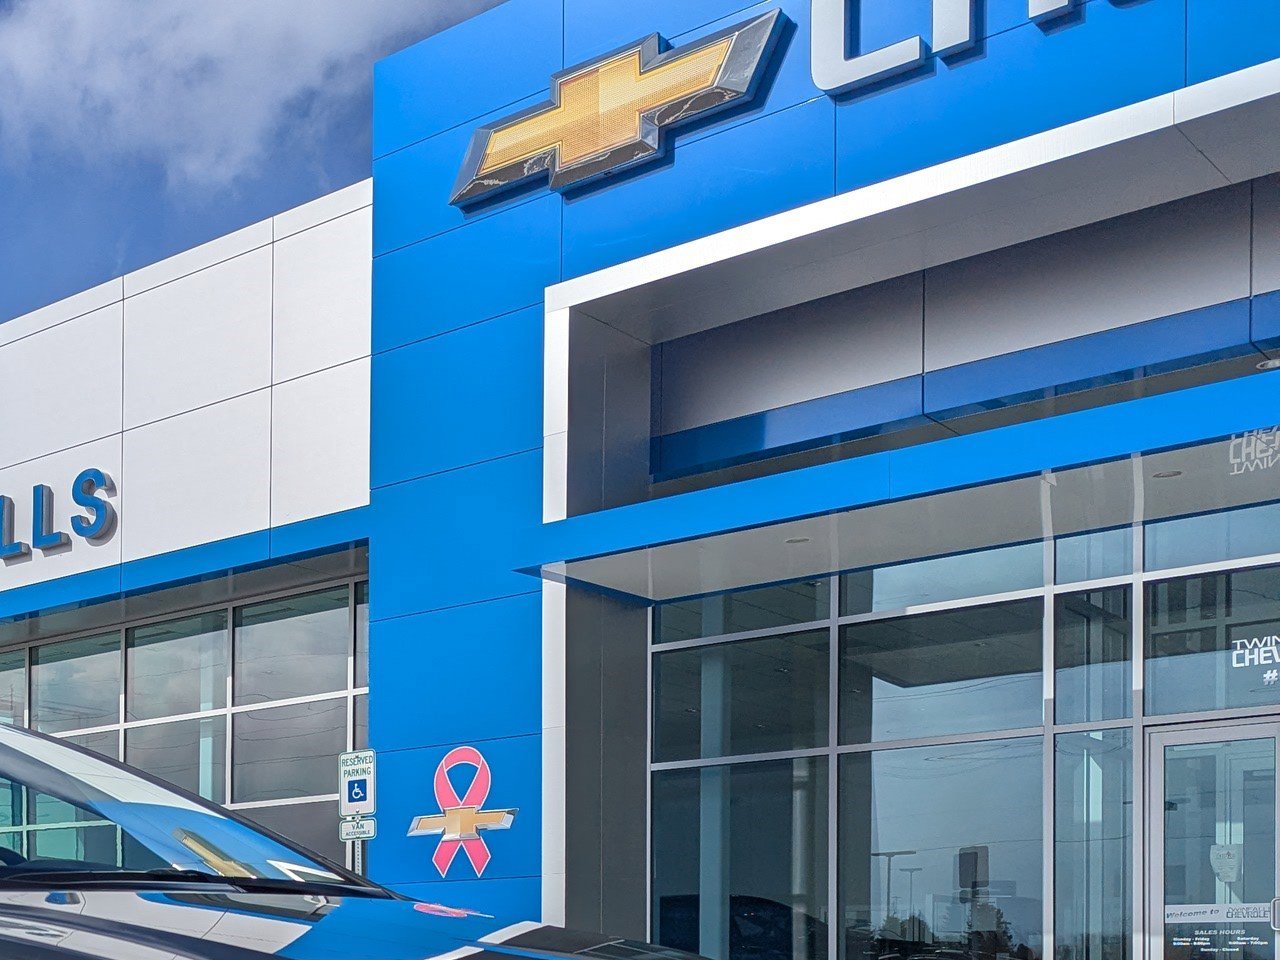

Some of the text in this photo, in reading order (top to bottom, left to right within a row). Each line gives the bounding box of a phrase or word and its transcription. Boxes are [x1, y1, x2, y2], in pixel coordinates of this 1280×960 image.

[341, 755, 373, 767] RESERVED
[343, 767, 371, 778] PARKING
[345, 829, 370, 837] ACCESSIBLE
[1166, 910, 1207, 919] Welcome
